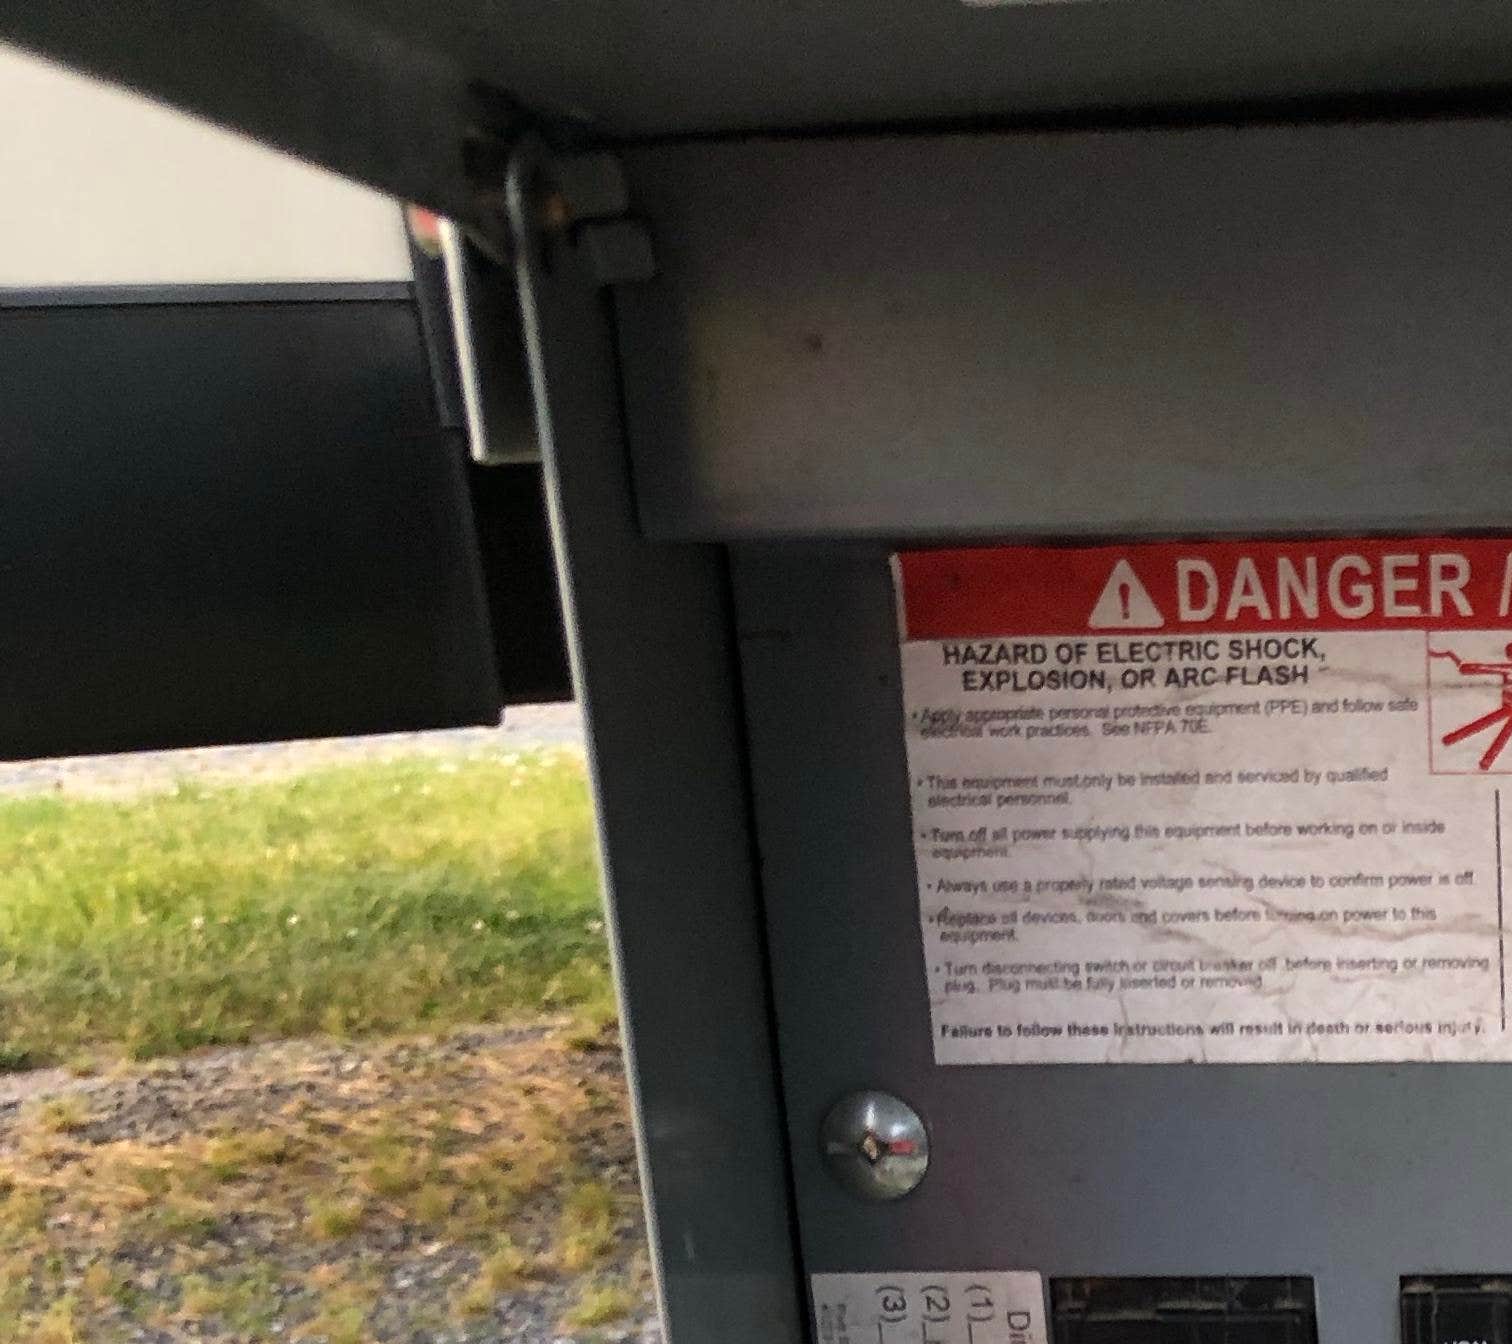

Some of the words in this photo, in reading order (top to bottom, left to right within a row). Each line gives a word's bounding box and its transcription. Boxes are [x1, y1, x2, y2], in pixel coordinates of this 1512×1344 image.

[1178, 553, 1474, 622] DANGER
[942, 642, 1047, 665] HAZARD
[1055, 642, 1087, 664] OF
[1096, 640, 1219, 664] ELECTRIC
[1229, 638, 1325, 662] SHOCK,
[962, 669, 1112, 692] EXPLOSION,
[1121, 668, 1155, 689] OR
[1164, 667, 1217, 688] ARC
[1225, 664, 1308, 686] FLASH
